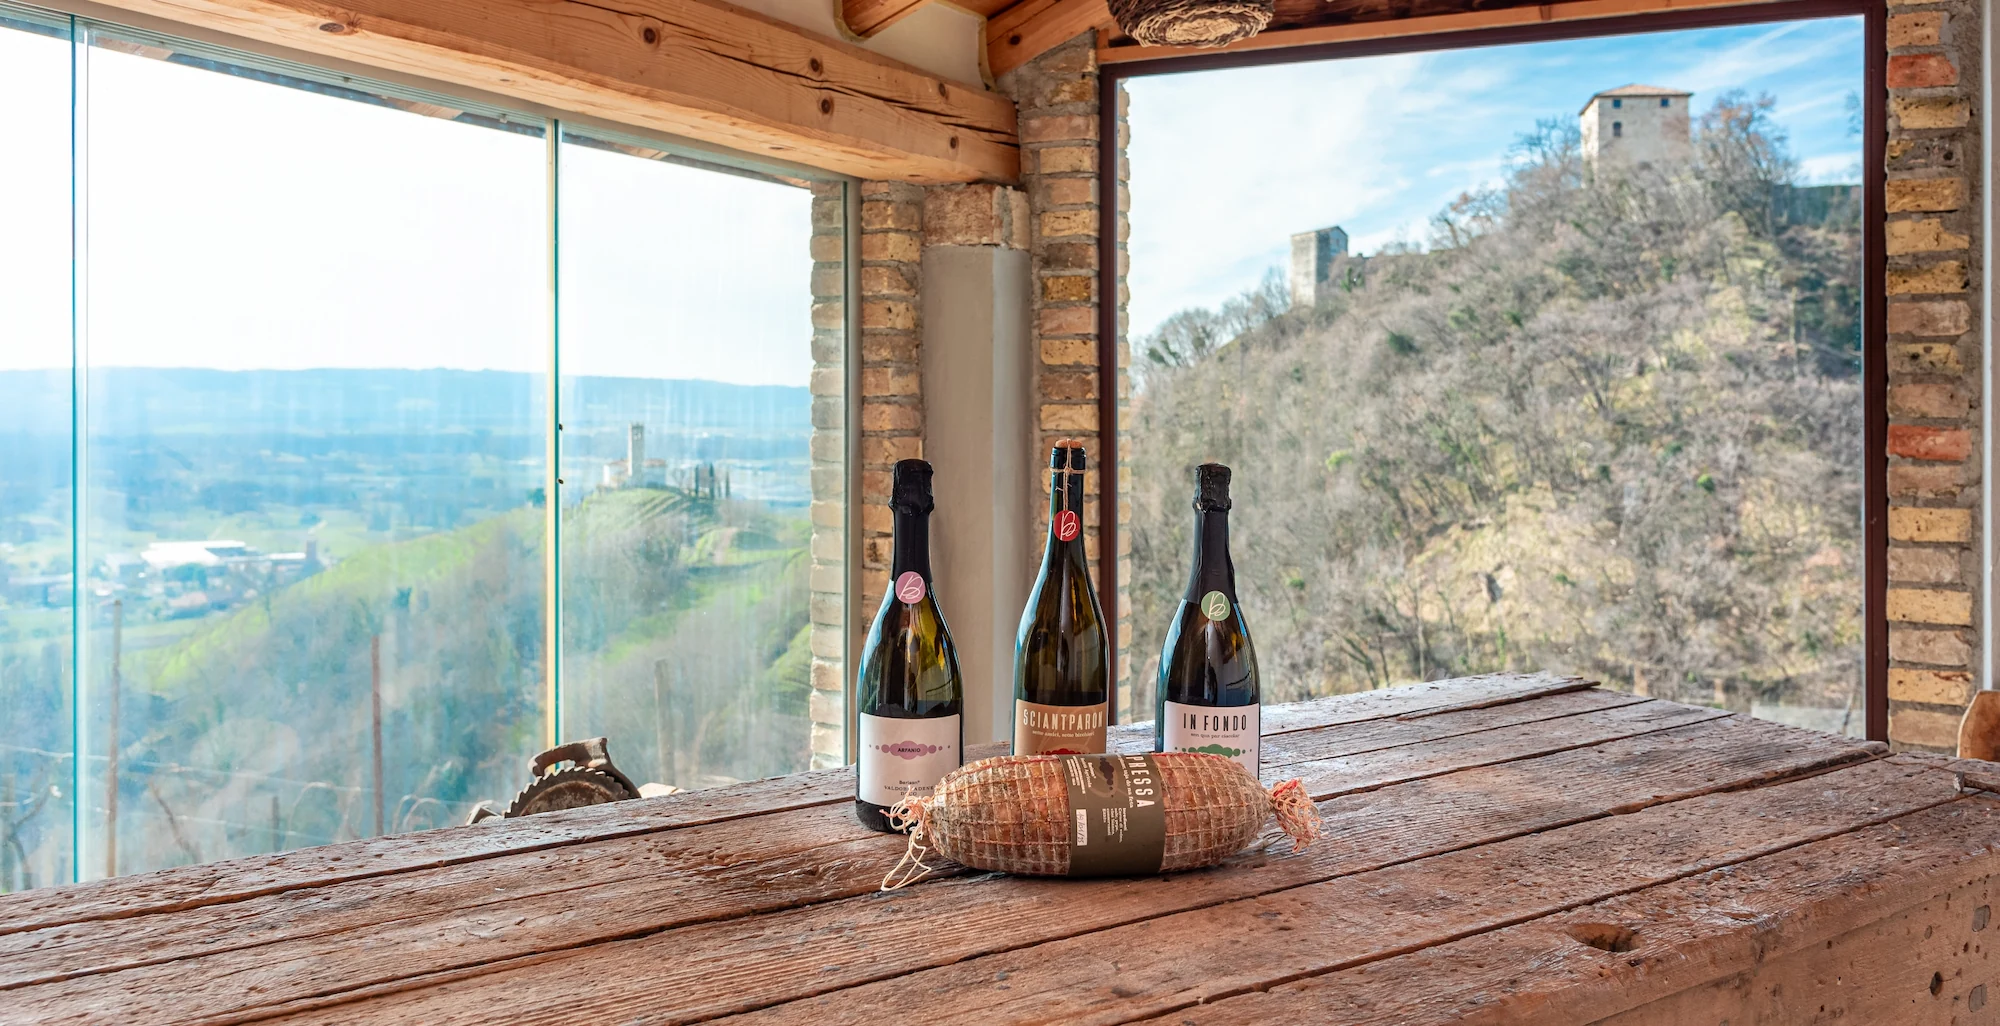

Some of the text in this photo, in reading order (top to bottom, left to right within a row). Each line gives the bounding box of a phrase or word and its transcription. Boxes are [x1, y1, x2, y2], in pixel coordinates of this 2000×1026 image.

[1023, 708, 1104, 731] SCIANTPARON
[1183, 713, 1247, 732] IN FONDO
[1123, 752, 1155, 808] PRESSA
